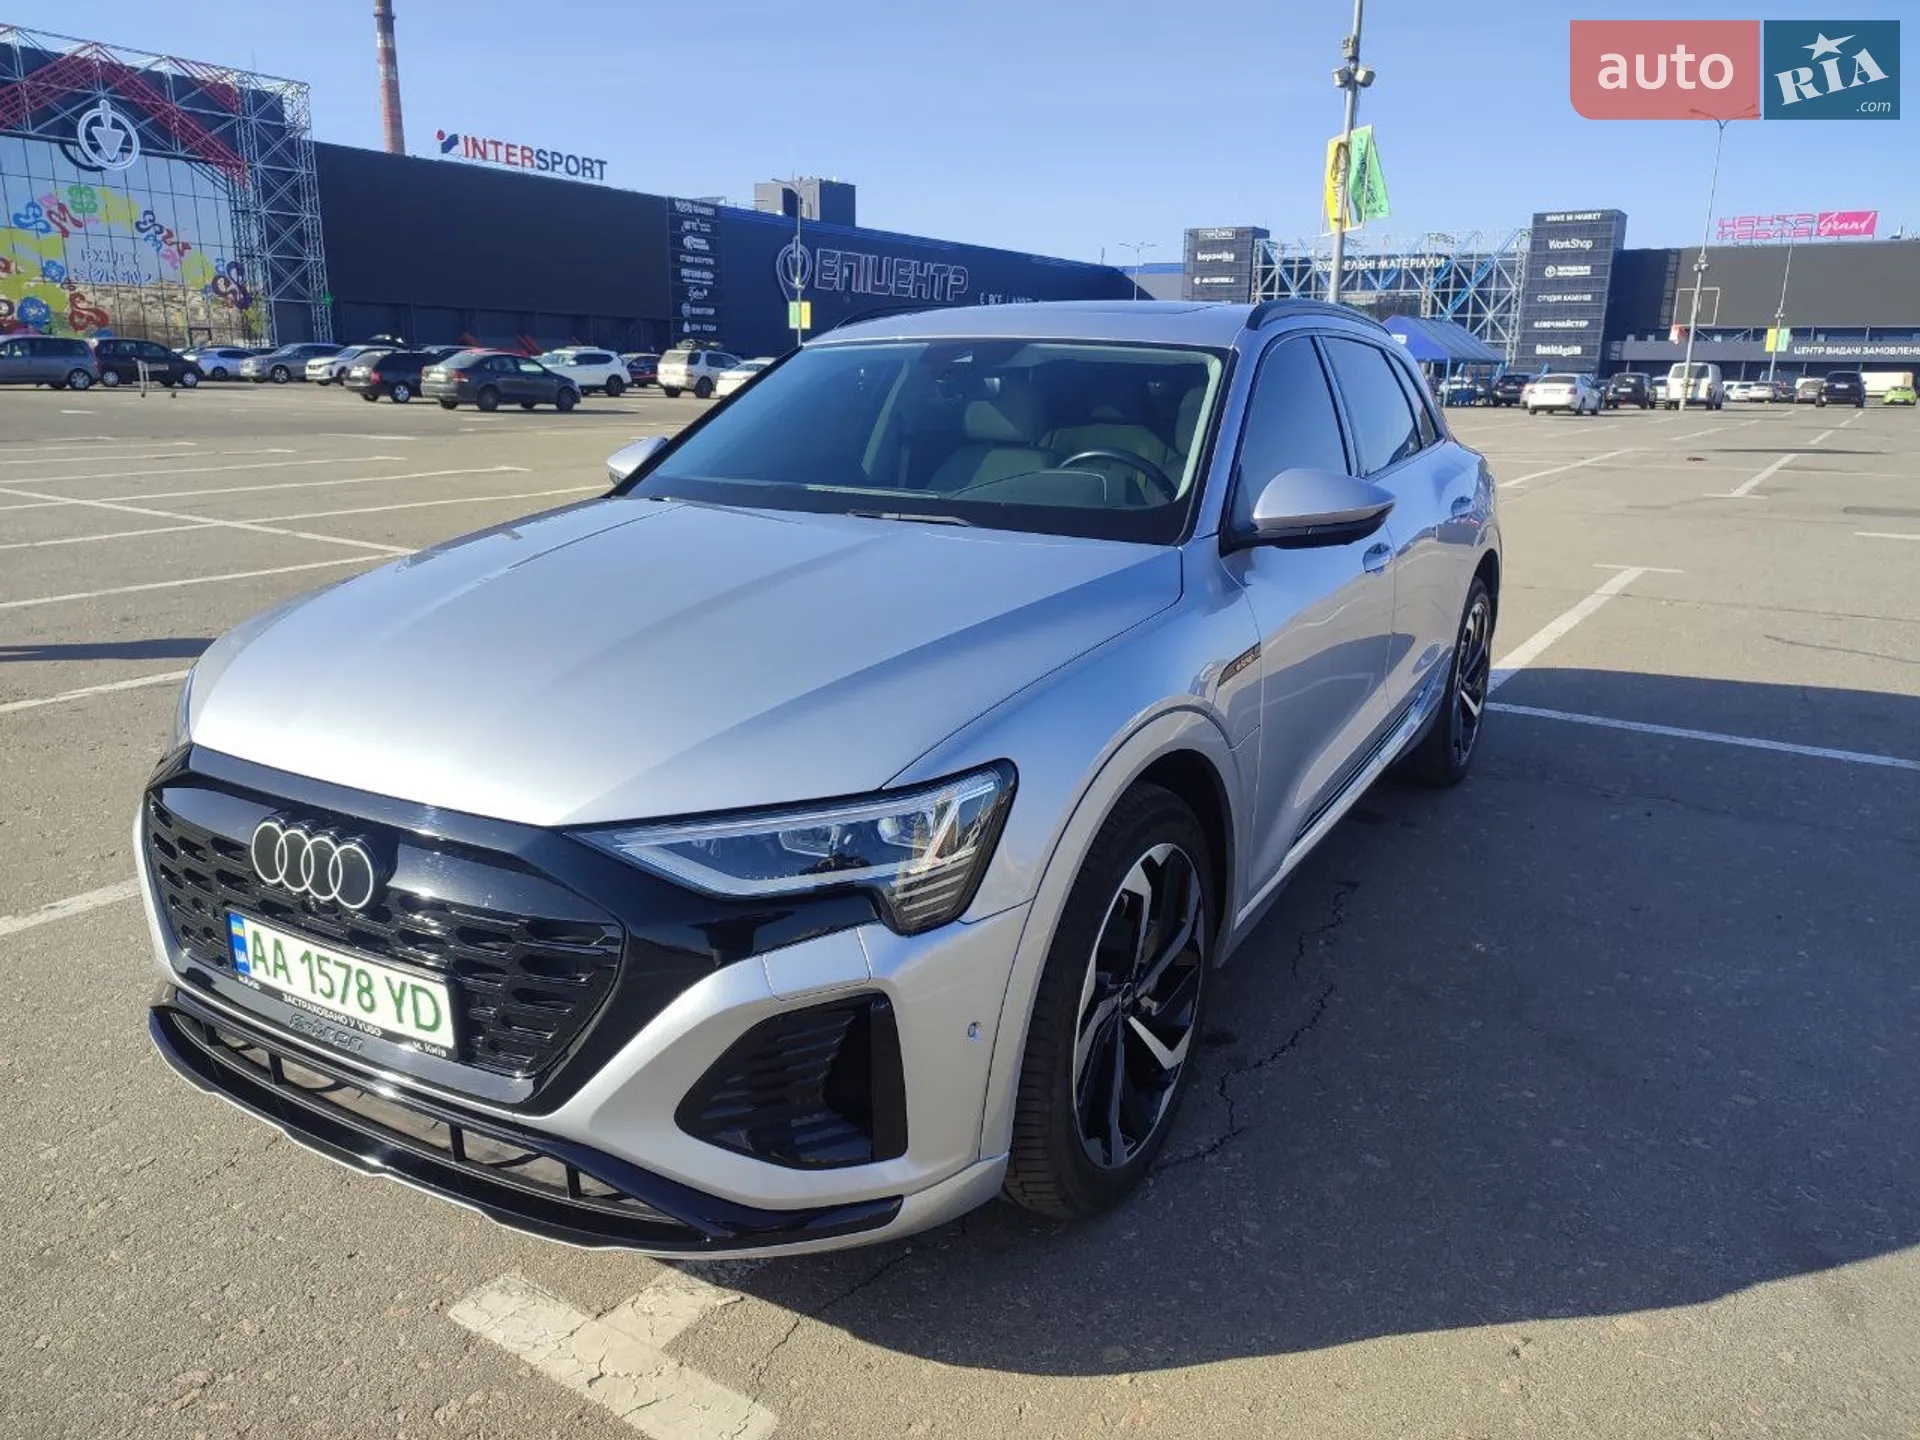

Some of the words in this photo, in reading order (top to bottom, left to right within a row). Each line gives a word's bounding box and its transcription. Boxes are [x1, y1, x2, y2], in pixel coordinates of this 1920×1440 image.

[463, 135, 608, 181] INTERSPORT
[1819, 211, 1875, 237] Grand
[814, 248, 969, 301] ЕПІЦЕНТР
[1316, 259, 1376, 271] БУДЕЛЬНІ
[1378, 257, 1446, 270] МАТЕРІАЛИ
[1794, 345, 1825, 355] ЦЕНТР
[1825, 346, 1861, 355] ВИДАЧІ
[251, 930, 293, 985] AA
[300, 949, 378, 1014] 1578
[385, 975, 442, 1033] YD
